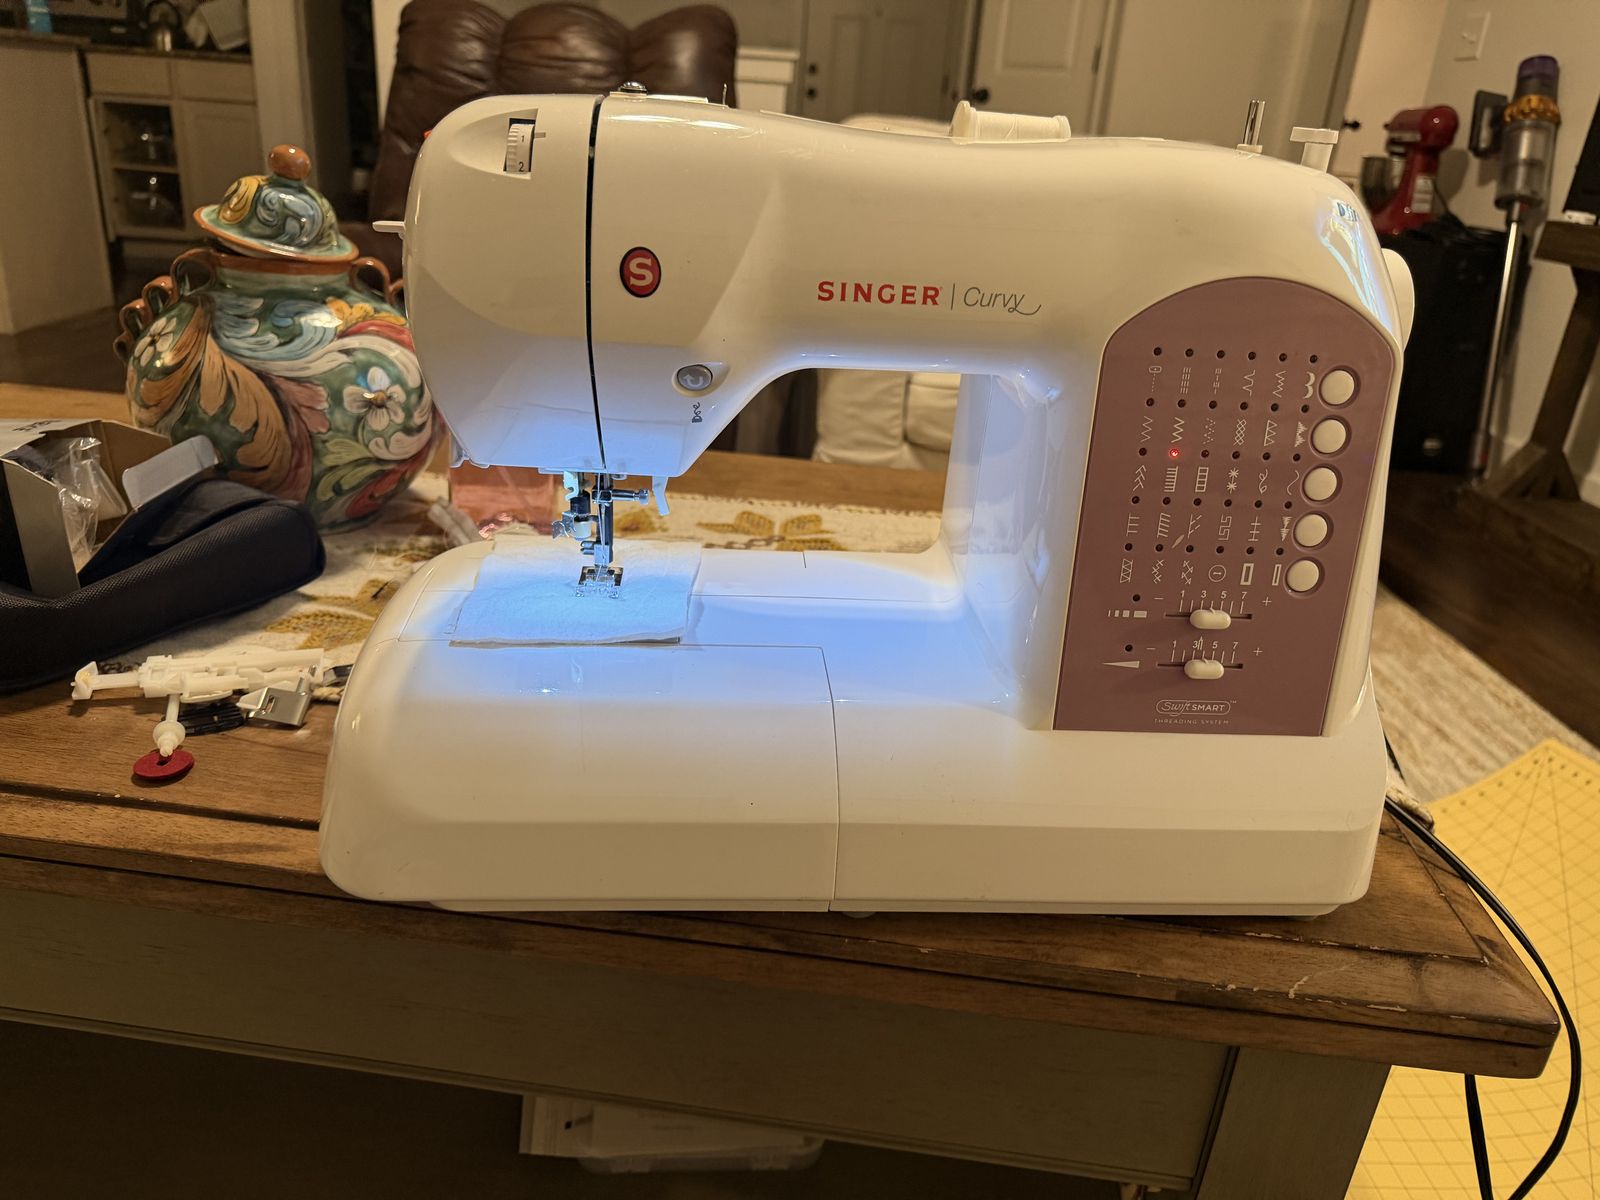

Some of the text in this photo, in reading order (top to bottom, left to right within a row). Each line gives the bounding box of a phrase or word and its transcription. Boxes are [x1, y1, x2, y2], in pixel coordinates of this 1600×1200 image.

[518, 161, 525, 172] 2
[629, 257, 654, 287] S
[817, 280, 1042, 316] SINGER Curvy
[1201, 590, 1207, 598] 3
[1220, 590, 1228, 599] 5
[1241, 591, 1248, 600] 7
[1212, 641, 1218, 649] 5
[1232, 641, 1239, 650] 7
